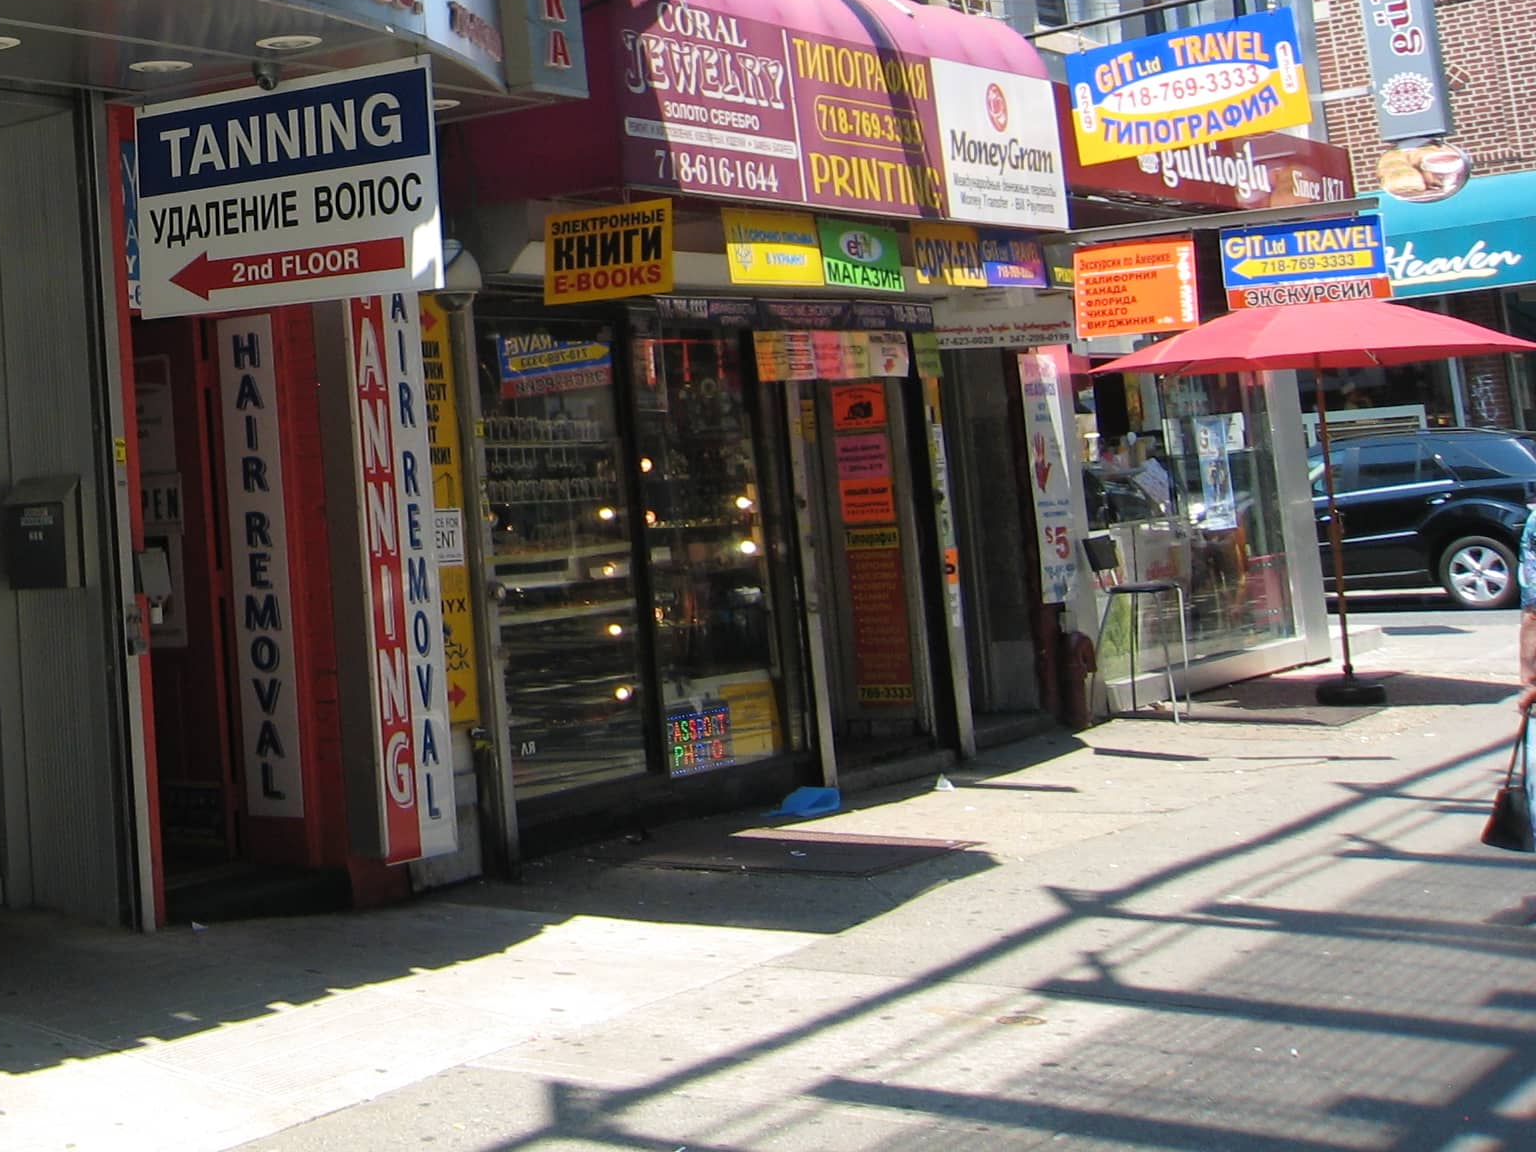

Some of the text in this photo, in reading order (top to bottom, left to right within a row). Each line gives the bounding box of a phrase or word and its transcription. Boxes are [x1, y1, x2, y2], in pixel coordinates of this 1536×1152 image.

[657, 2, 748, 48] CORAL
[622, 29, 785, 110] JEWELRY
[792, 38, 929, 101] ТИПОГРАФИЯ
[1094, 31, 1271, 94] GIT Ltd TRAVEL
[1114, 63, 1261, 112] 718-769-3333
[664, 101, 760, 131] ЗОЛОТО СЕРЕБРО
[818, 104, 924, 146] 718-769-3333
[1100, 85, 1281, 145] ТИПОГРАФИЯ
[160, 92, 403, 179] TANNING
[950, 129, 1054, 176] MoneyGram
[809, 152, 943, 210] PRINTING
[1291, 171, 1345, 201] Since 1871
[150, 172, 423, 249] УДАЛЕНИЕ ВОЛОС
[551, 207, 666, 235] ЭЛЕКТРОННЫЕ
[553, 226, 663, 272] КНИГИ
[1225, 225, 1379, 261] GIT Ltd TRAVEL
[232, 247, 360, 283] 2nd FLOOR
[553, 264, 662, 295] E-BOOKS
[827, 261, 902, 290] МАГАЗИН
[1261, 253, 1356, 274] 718-769-3333
[1085, 286, 1127, 296] КАНАДА
[1086, 296, 1137, 308] ФЛОРИДА
[1247, 280, 1372, 307] ЭКСКУРСИИ
[1086, 308, 1128, 318] ЧИКАГО
[142, 487, 179, 521] PEN
[390, 292, 443, 821] AIR REMOVAL
[436, 530, 456, 549] ENT
[232, 332, 287, 801] HAIR REMOVAL
